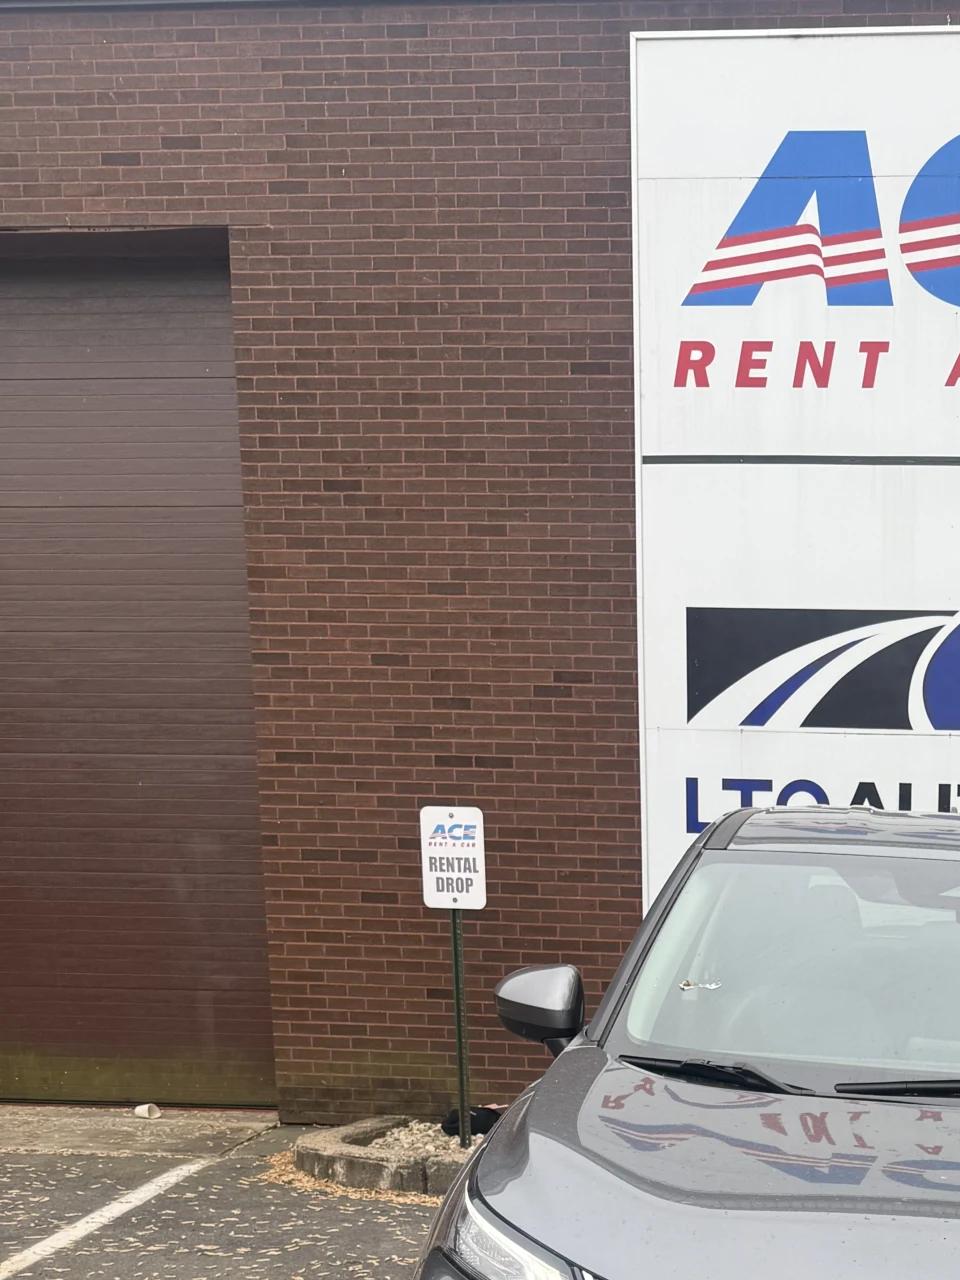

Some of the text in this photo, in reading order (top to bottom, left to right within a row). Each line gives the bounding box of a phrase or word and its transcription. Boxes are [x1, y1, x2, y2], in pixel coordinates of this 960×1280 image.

[673, 340, 889, 388] RENT
[429, 824, 477, 840] ACE
[429, 856, 480, 873] RENTAL
[435, 877, 474, 893] DROP
